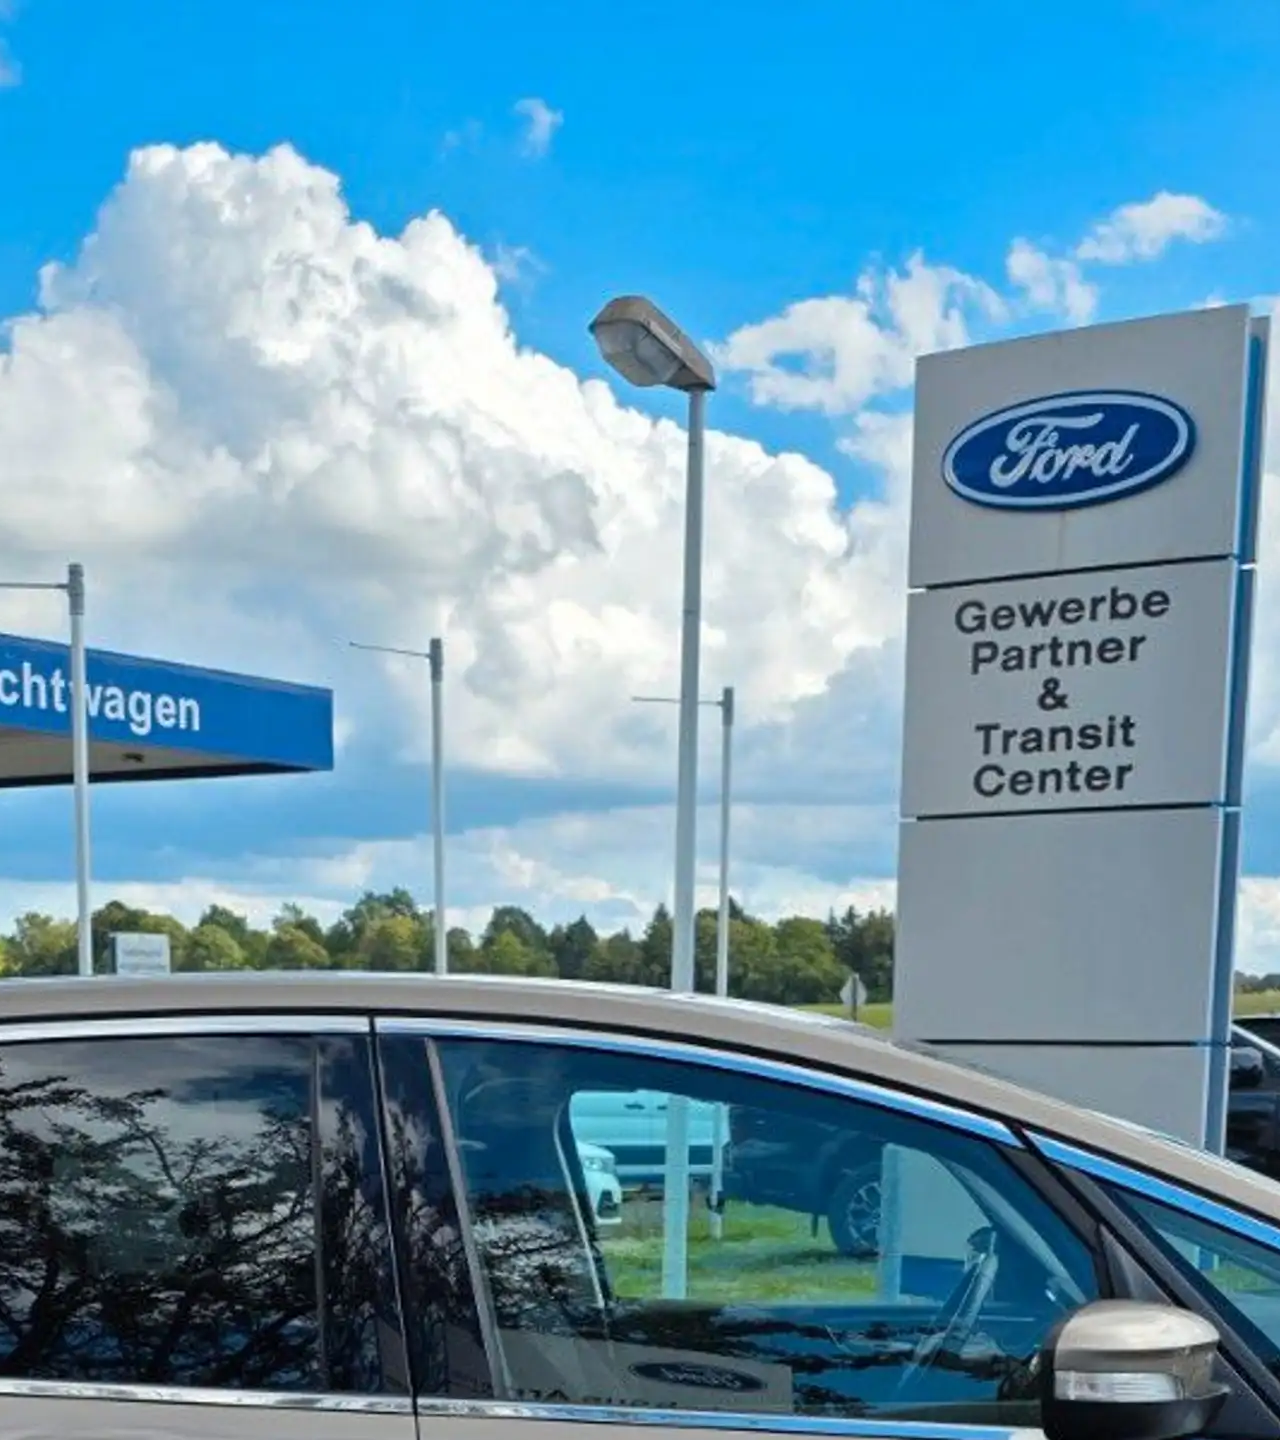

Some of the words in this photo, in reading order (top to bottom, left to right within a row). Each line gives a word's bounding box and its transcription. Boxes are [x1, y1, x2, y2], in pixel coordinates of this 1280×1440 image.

[990, 413, 1139, 488] Ford
[955, 586, 1171, 634] Gewerbe
[971, 633, 1147, 674] Partner
[1038, 677, 1069, 710] &
[975, 715, 1136, 756] Transit
[973, 761, 1134, 797] Center
